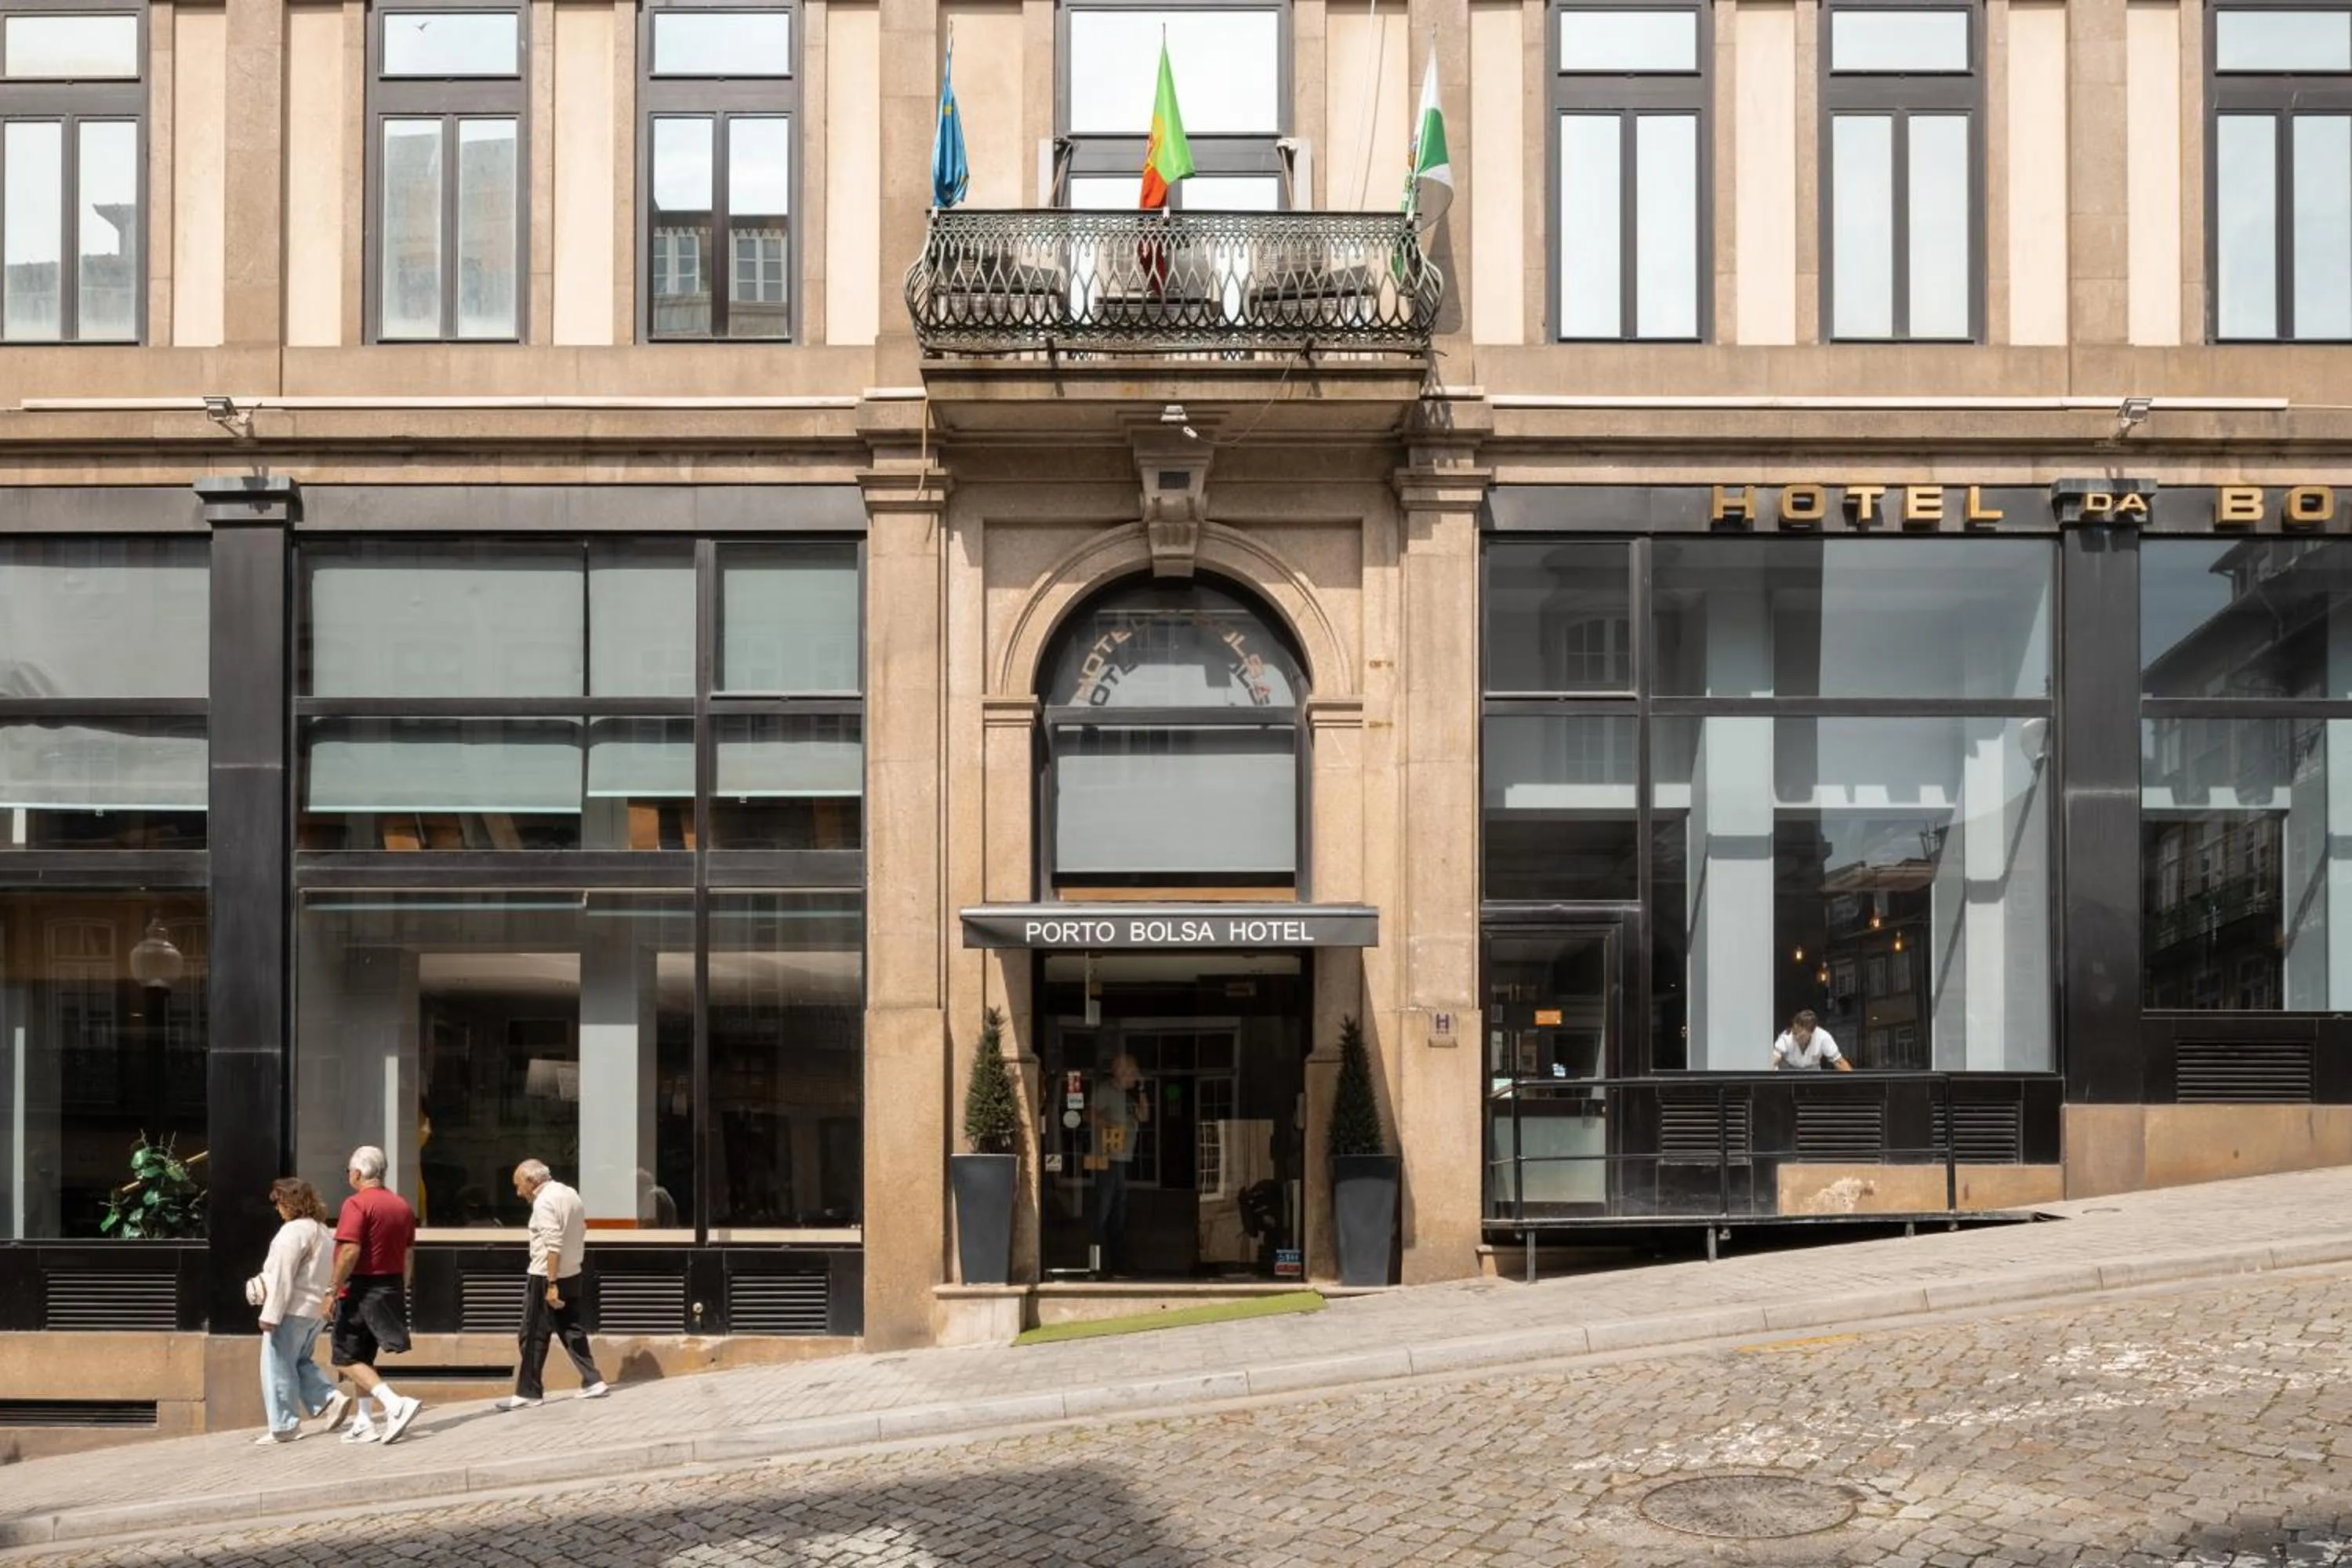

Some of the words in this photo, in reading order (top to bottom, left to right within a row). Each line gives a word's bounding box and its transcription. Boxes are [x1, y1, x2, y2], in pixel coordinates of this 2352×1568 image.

[1711, 484, 2003, 522] HOTEL
[2083, 492, 2150, 513] DA
[2216, 485, 2334, 523] BO
[1025, 921, 1116, 944] PORTO
[1129, 920, 1215, 942] BOLSA
[1229, 920, 1315, 942] HOTEL
[1436, 1013, 1449, 1029] H
